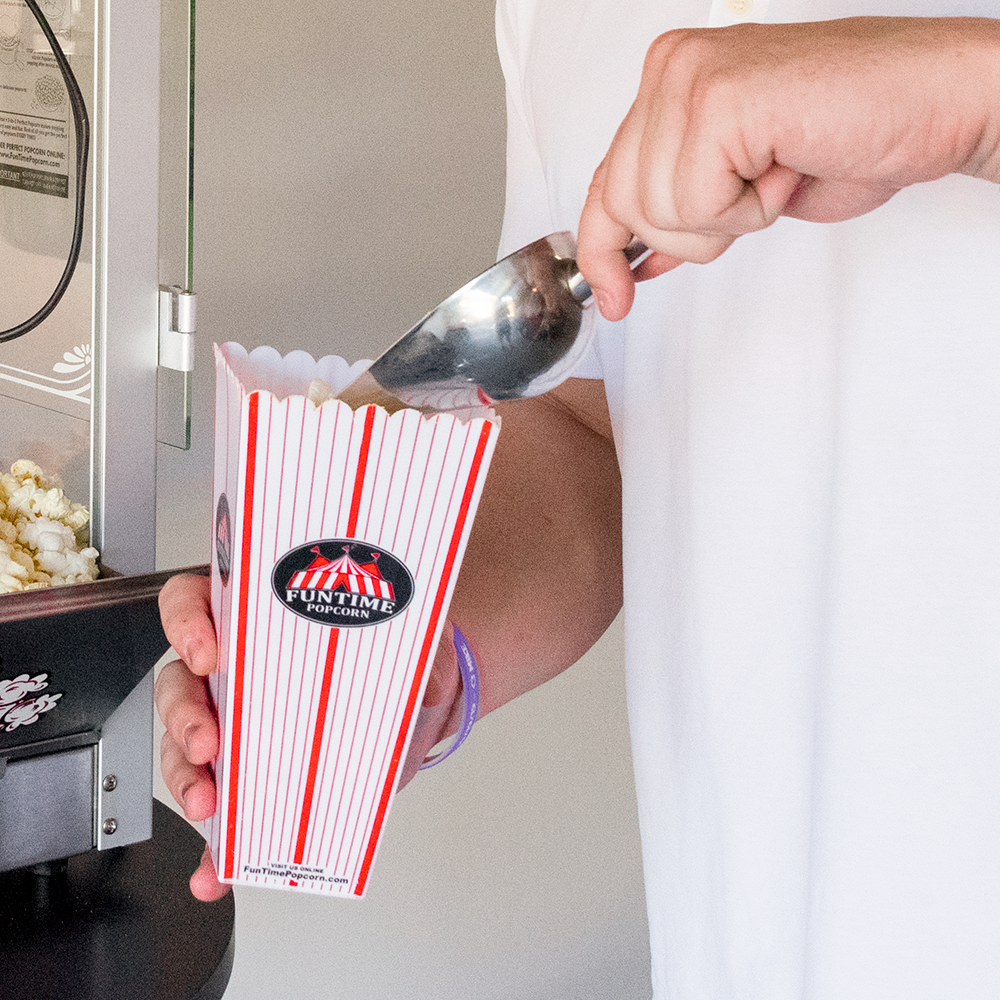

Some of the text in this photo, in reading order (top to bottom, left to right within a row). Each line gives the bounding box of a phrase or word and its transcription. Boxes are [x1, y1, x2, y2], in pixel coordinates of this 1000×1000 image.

[6, 142, 24, 152] PERFECT
[24, 145, 46, 155] POPCORN
[285, 589, 396, 615] FUNTIME
[306, 603, 370, 619] POPCORN
[243, 865, 349, 884] FunTimePopcorn.com
[270, 862, 288, 870] VISIT
[299, 866, 324, 874] ONLINE
